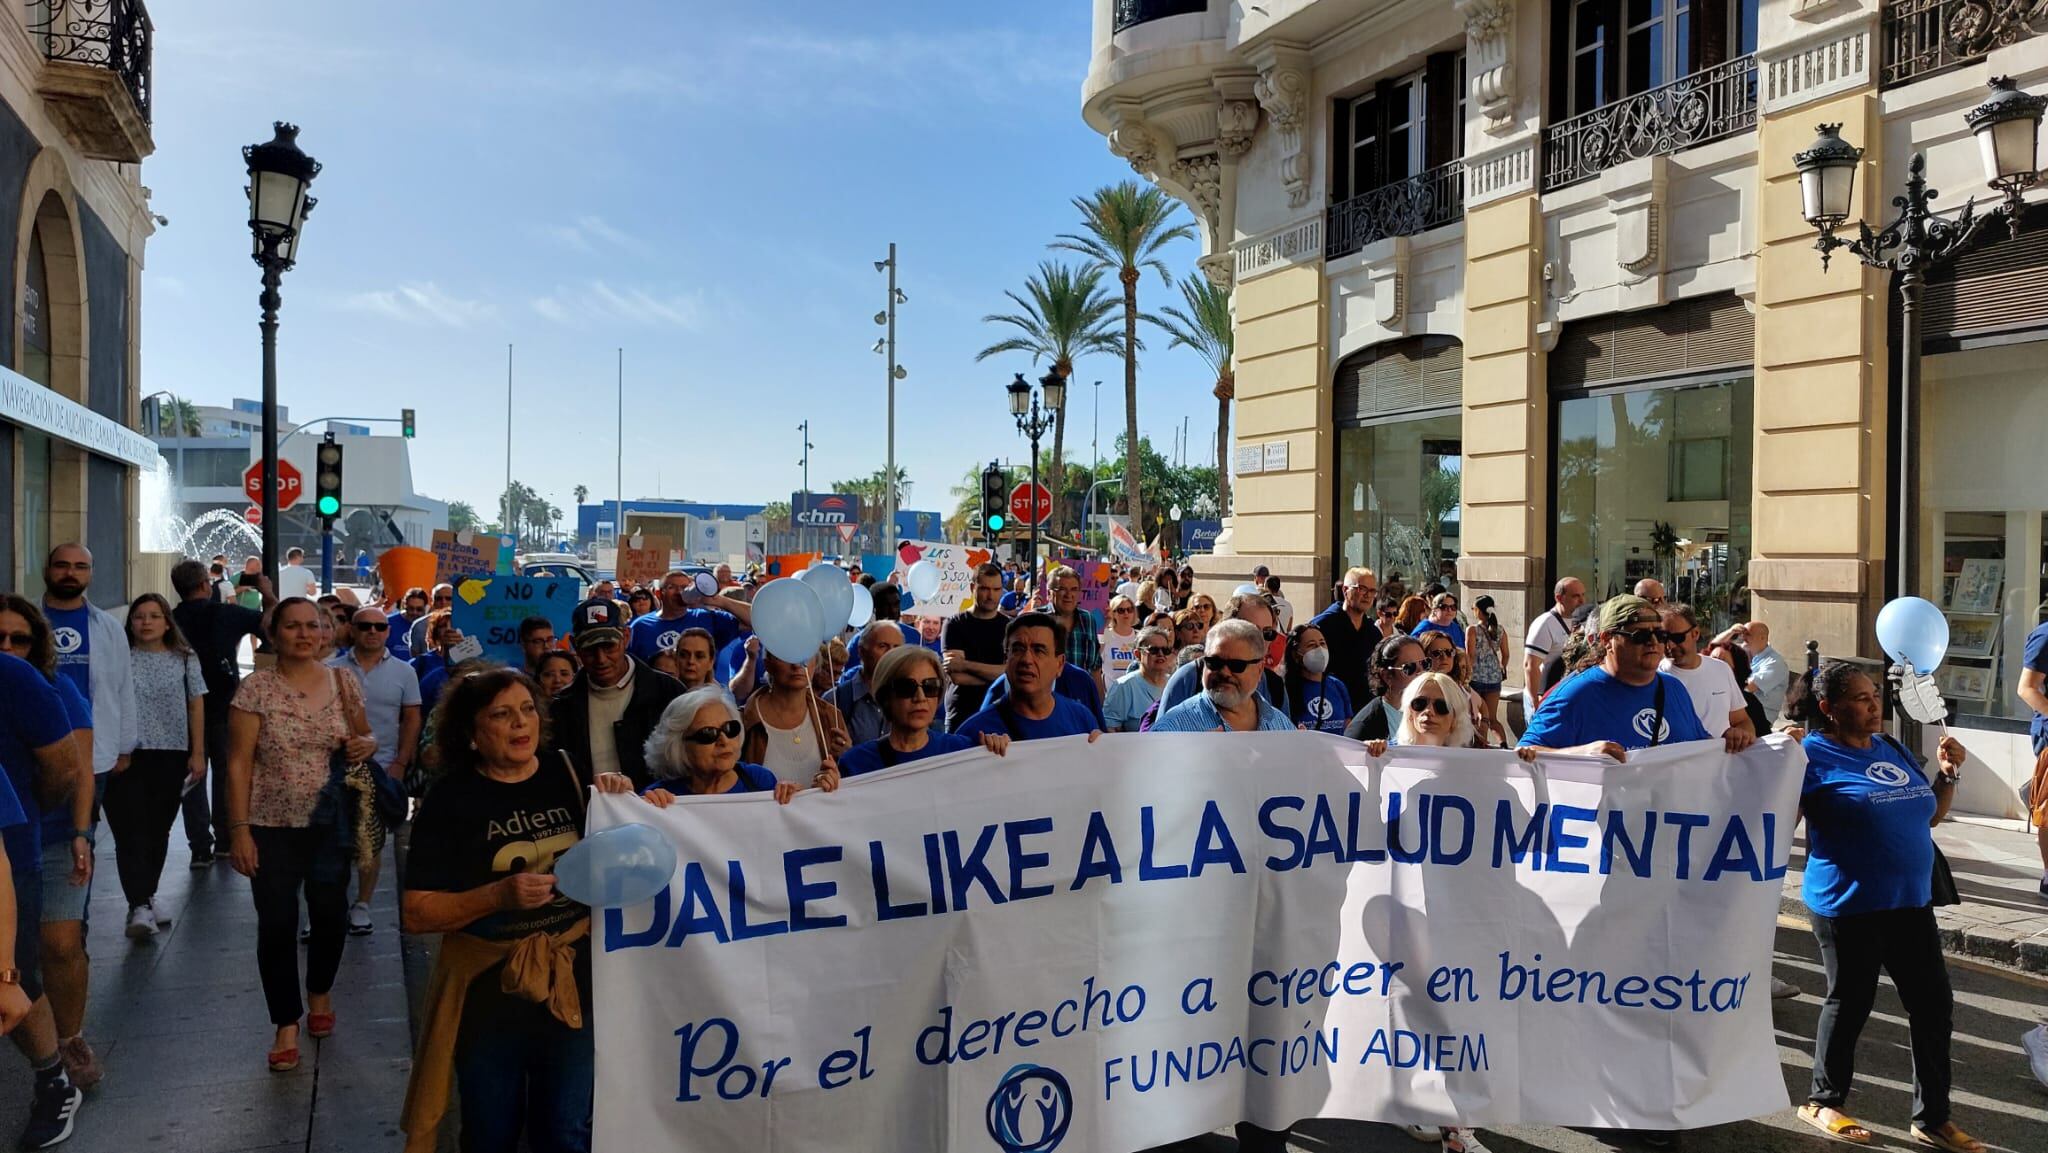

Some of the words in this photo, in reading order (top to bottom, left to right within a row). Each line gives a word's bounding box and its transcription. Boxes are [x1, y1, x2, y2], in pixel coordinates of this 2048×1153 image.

[2, 380, 53, 424] NAVEGACIÓN
[55, 405, 64, 427] DE
[249, 477, 299, 491] SOP
[797, 509, 846, 523] chm
[1014, 499, 1049, 509] STP
[505, 582, 533, 600] NO
[487, 807, 572, 840] Adiem
[604, 846, 847, 952] DALE
[869, 817, 1055, 921] LIKE
[1069, 811, 1123, 891] A
[1139, 800, 1247, 881] LA
[1258, 792, 1475, 872] SALUD
[1491, 799, 1787, 881] MENTAL
[673, 1017, 791, 1102] Por
[817, 1026, 875, 1090] el
[915, 976, 1147, 1064] derecho
[1181, 977, 1217, 1015] a
[1247, 960, 1404, 1008] crecer
[1427, 965, 1479, 1002] en
[1499, 951, 1751, 1012] bienestar
[1105, 1021, 1339, 1100] FUNDACIÓN
[1360, 1028, 1489, 1072] ADIEM
